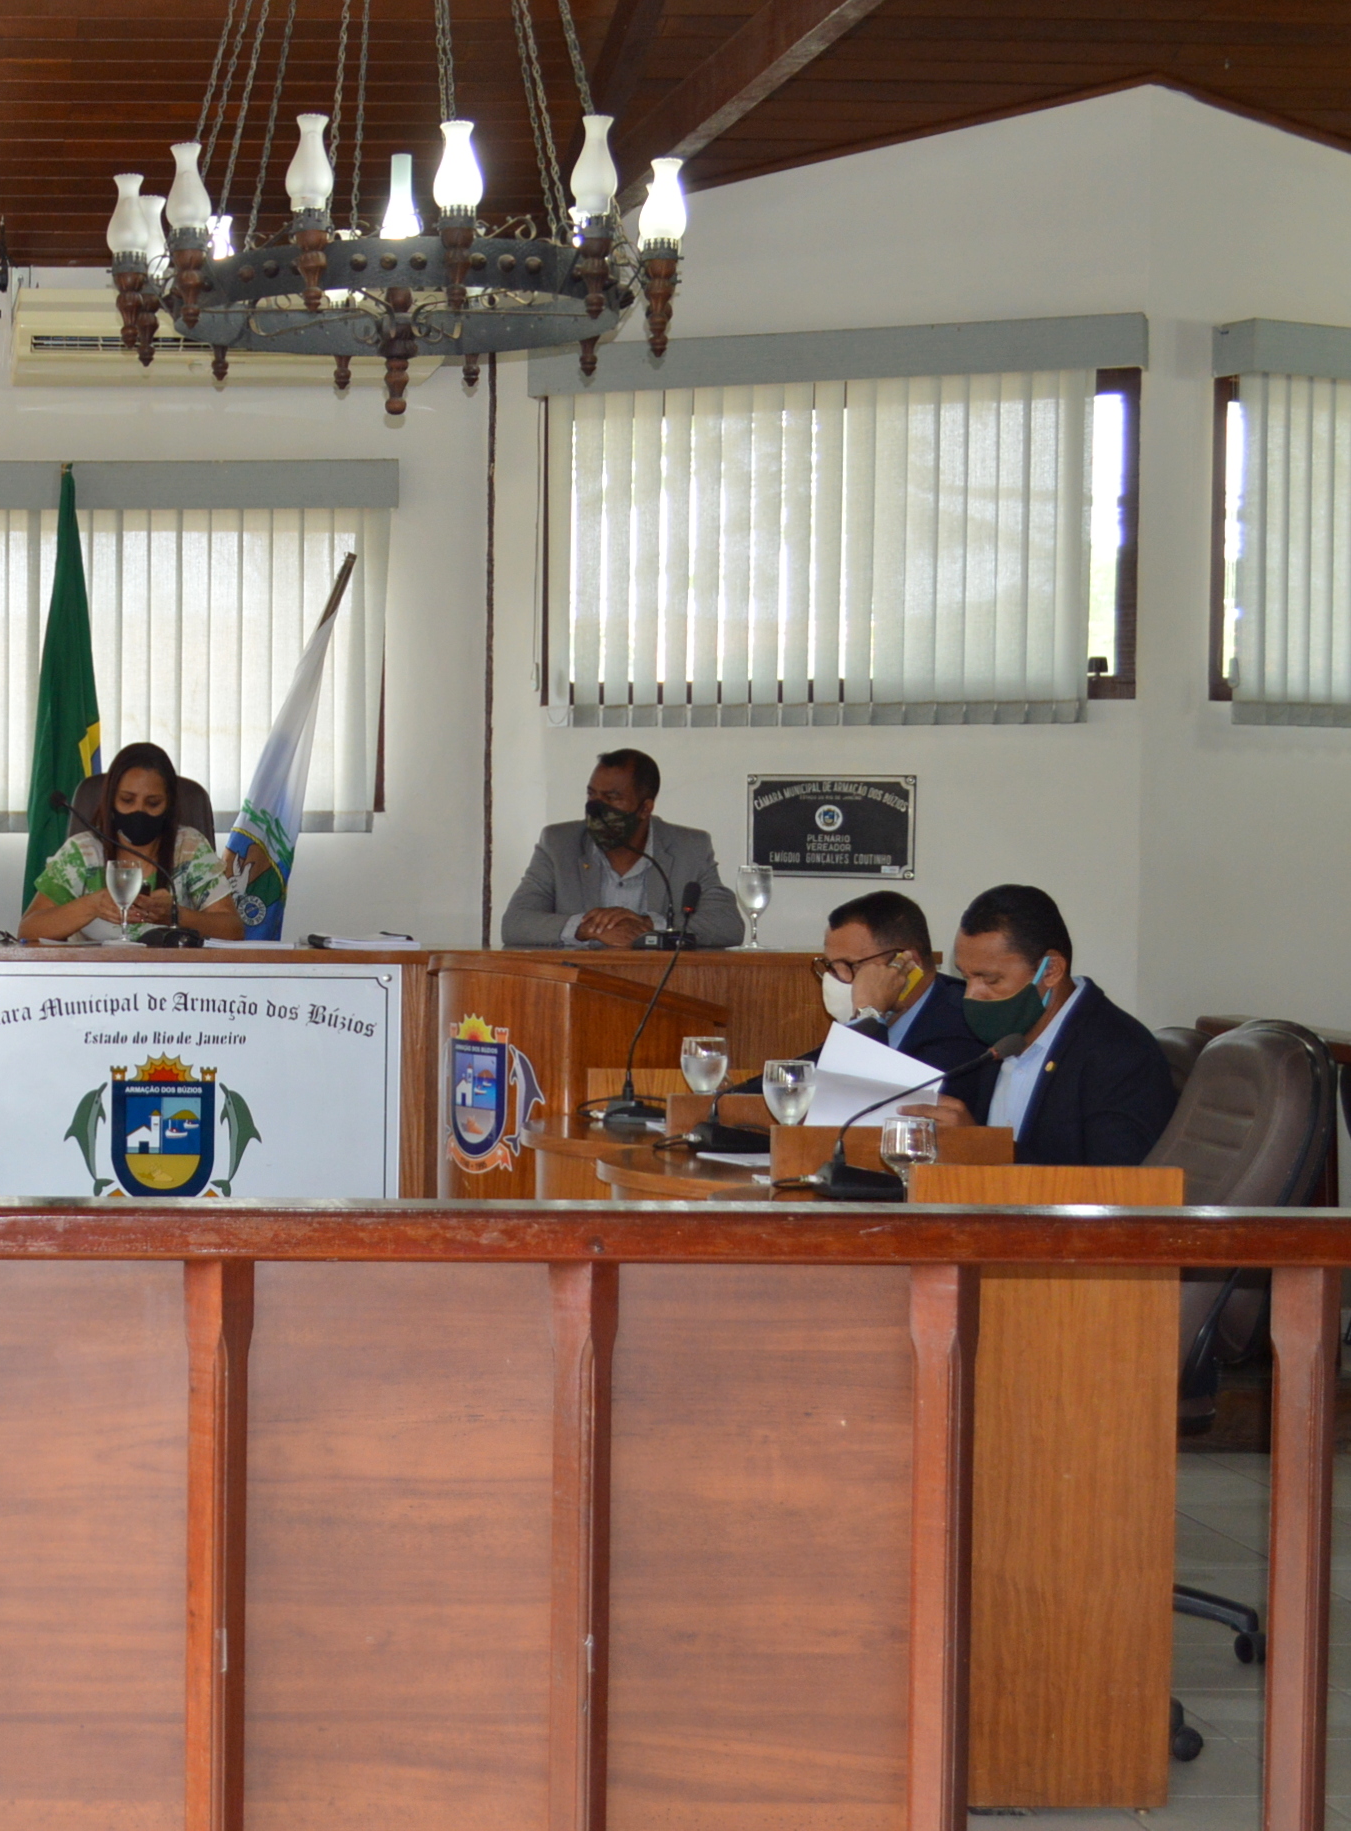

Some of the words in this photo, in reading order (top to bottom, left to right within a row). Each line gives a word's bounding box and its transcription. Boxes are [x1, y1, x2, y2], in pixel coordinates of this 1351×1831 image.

[754, 790, 784, 811] CÂMARA
[783, 782, 821, 798] MUNICIPAL
[822, 781, 833, 792] DE
[833, 781, 868, 797] ARMAÇÃO
[867, 786, 884, 801] DOS
[807, 834, 851, 843] PLENÁRIO
[806, 843, 851, 851] VEREADOR
[769, 851, 801, 863] EMÍGDIO
[805, 852, 849, 866] GONÇALVES
[853, 854, 892, 865] COUTINHO
[38, 992, 139, 1022] Municipal
[147, 993, 167, 1012] de
[172, 991, 258, 1021] Armação
[265, 999, 300, 1022] dos
[305, 1003, 377, 1038] Búzios
[84, 1031, 128, 1044] Estado
[132, 1031, 148, 1044] do
[152, 1031, 174, 1045] Rio
[176, 1031, 192, 1045] de
[195, 1031, 247, 1046] Janeiro
[125, 1086, 160, 1095] ARMAÇÃO
[177, 1086, 202, 1094] BÚZIOS
